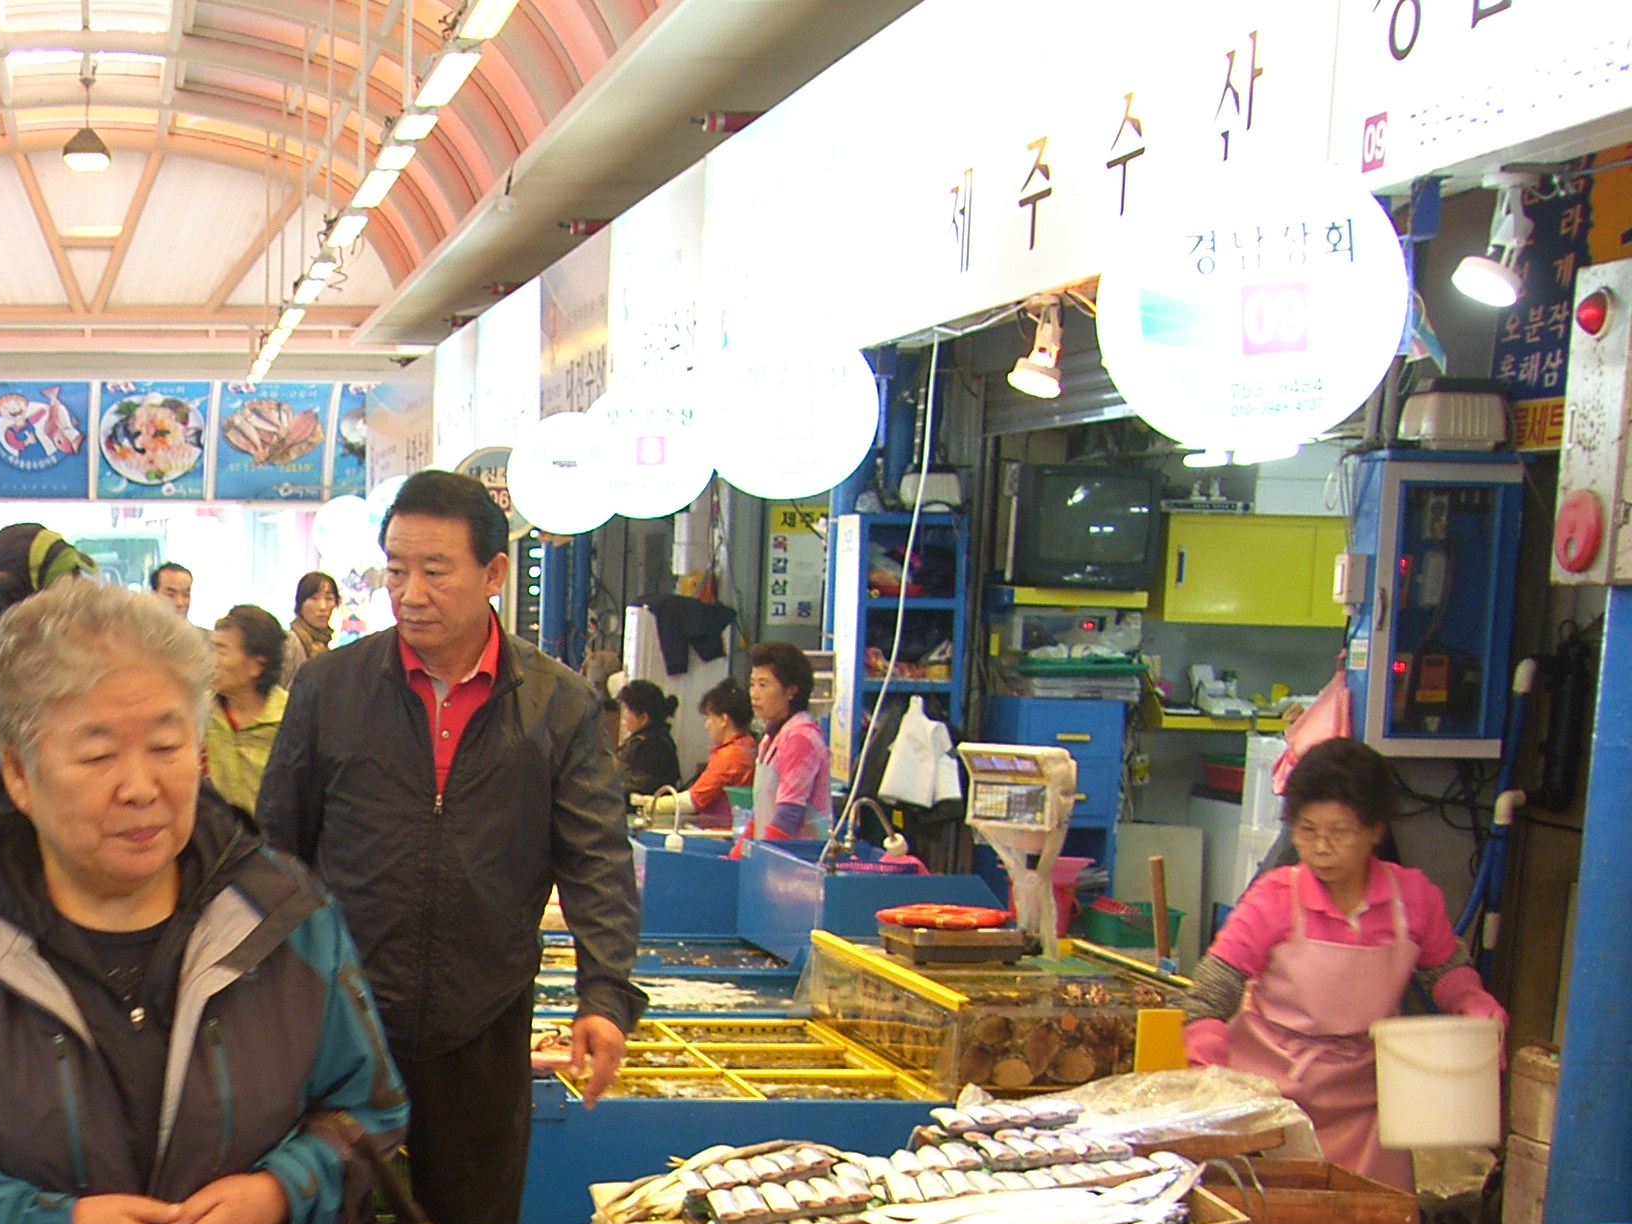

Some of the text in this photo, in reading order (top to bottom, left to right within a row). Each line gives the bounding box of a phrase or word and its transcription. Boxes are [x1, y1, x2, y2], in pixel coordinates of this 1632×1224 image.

[1364, 120, 1386, 164] 09
[1184, 217, 1356, 276] 경남상회
[1243, 287, 1308, 345] 09
